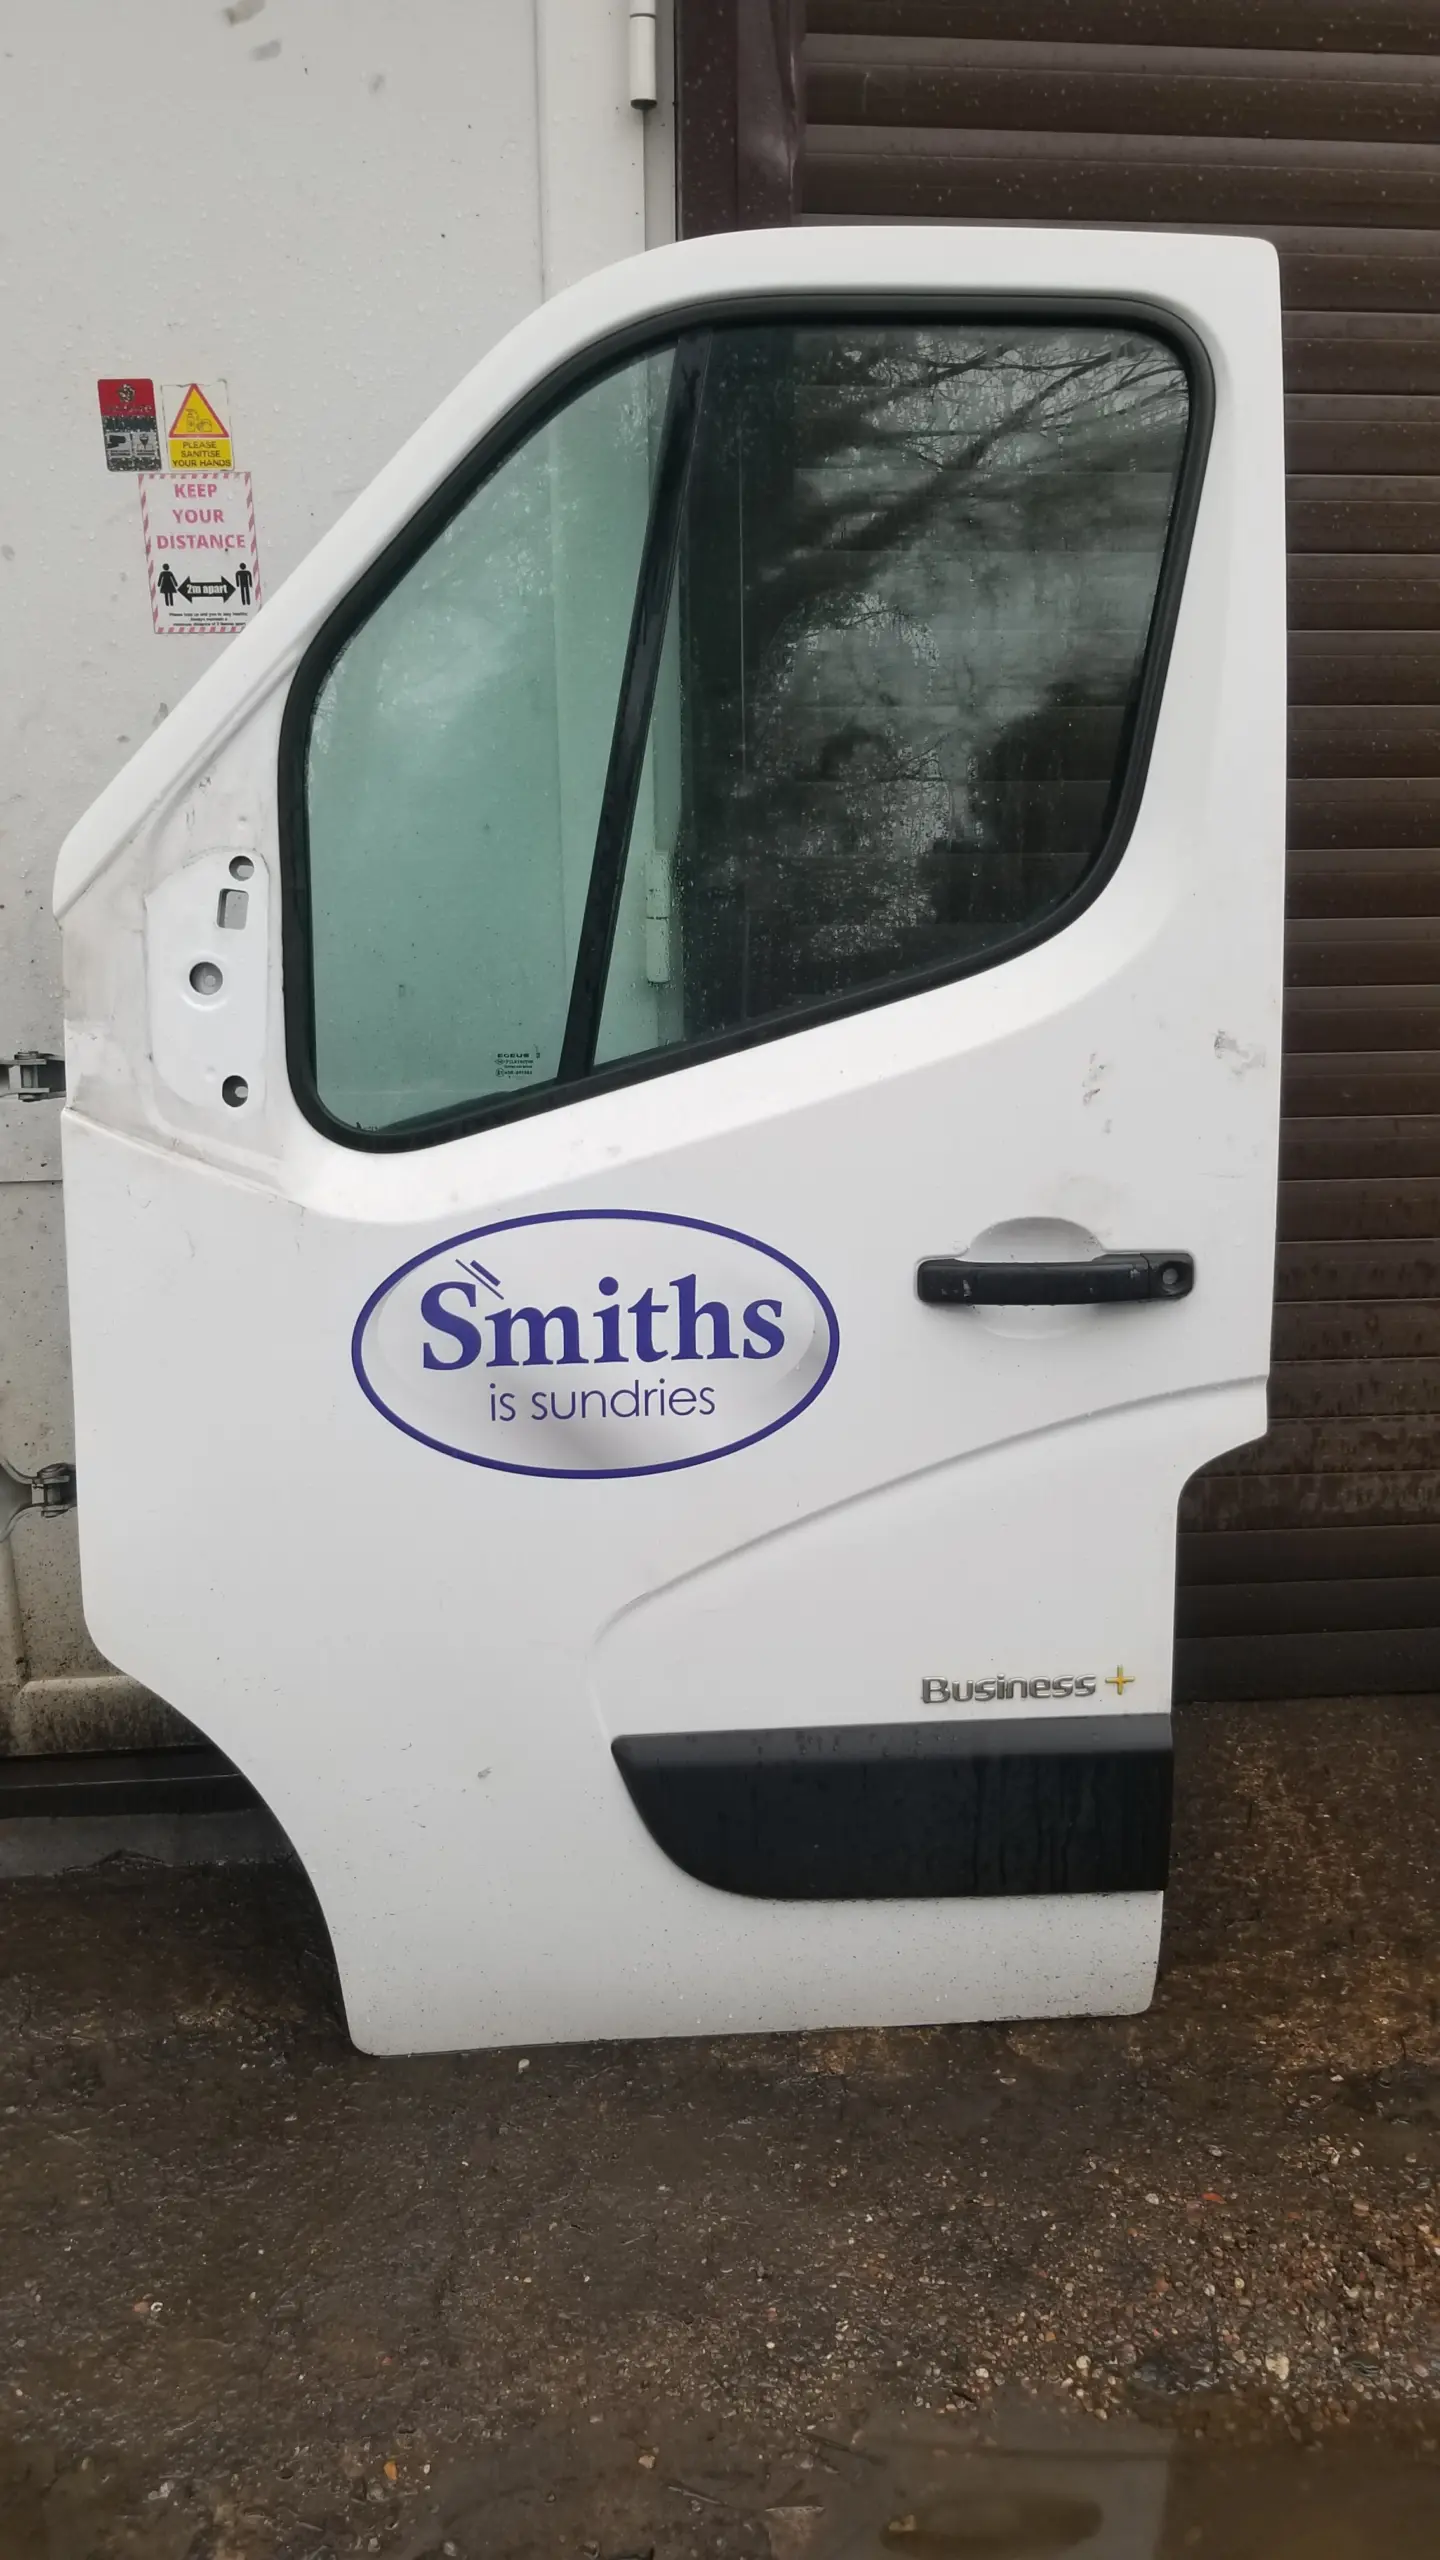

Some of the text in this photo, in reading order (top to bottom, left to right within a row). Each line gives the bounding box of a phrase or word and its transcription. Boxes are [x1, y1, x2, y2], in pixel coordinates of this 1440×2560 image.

[182, 441, 217, 449] PLEASE
[180, 450, 221, 458] SANITISE
[172, 459, 232, 468] YOUR HANDS
[174, 483, 218, 498] KEEP
[172, 509, 225, 523] YOUR
[156, 534, 246, 549] DISTANCE
[186, 584, 228, 595] 2m apart
[420, 1273, 786, 1371] Smiths
[489, 1378, 716, 1422] is sundries
[920, 1673, 1097, 1704] Business
